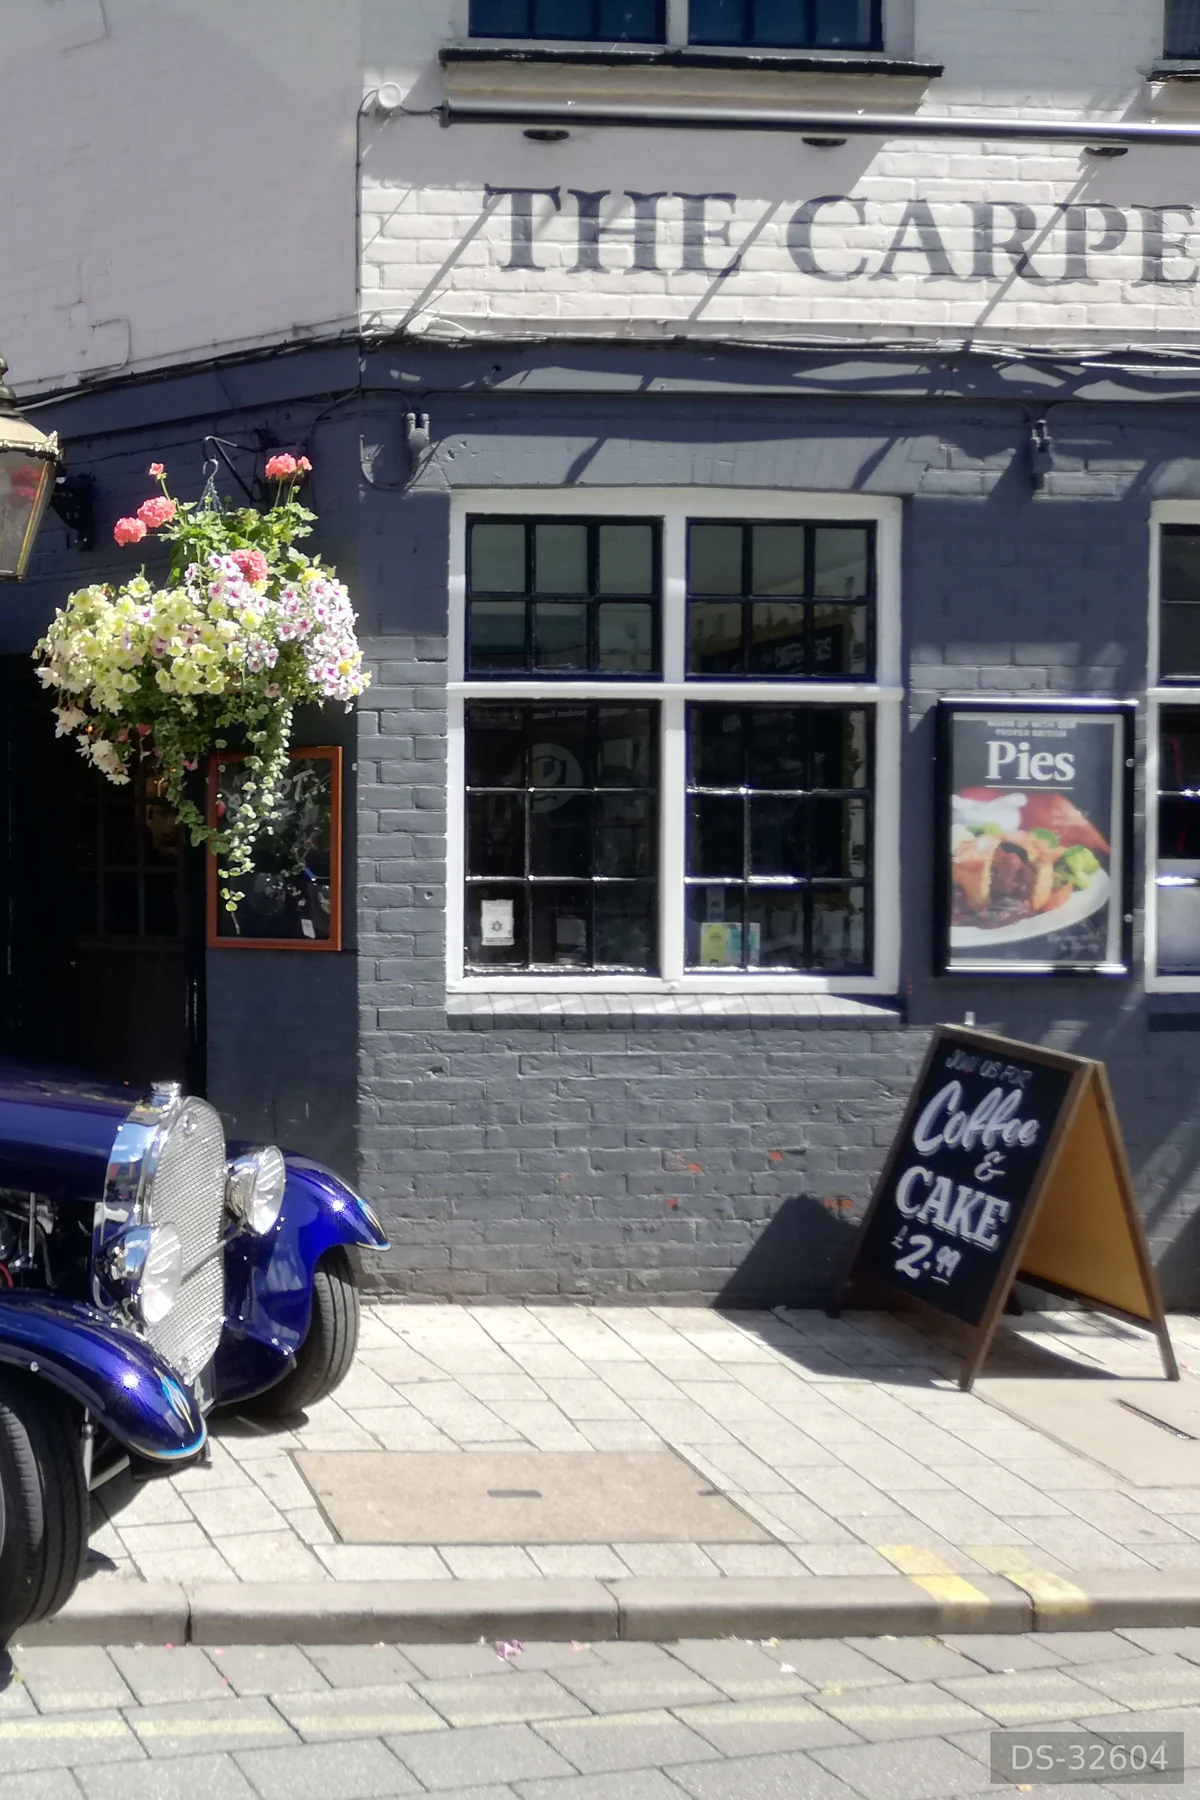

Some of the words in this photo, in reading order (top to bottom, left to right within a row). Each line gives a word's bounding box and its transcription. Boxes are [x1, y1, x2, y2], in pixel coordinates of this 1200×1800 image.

[484, 183, 742, 276] THE
[985, 740, 1076, 782] Pies
[913, 1080, 1041, 1156] Coffee
[973, 1150, 1007, 1182] &
[896, 1165, 1012, 1252] CAKE
